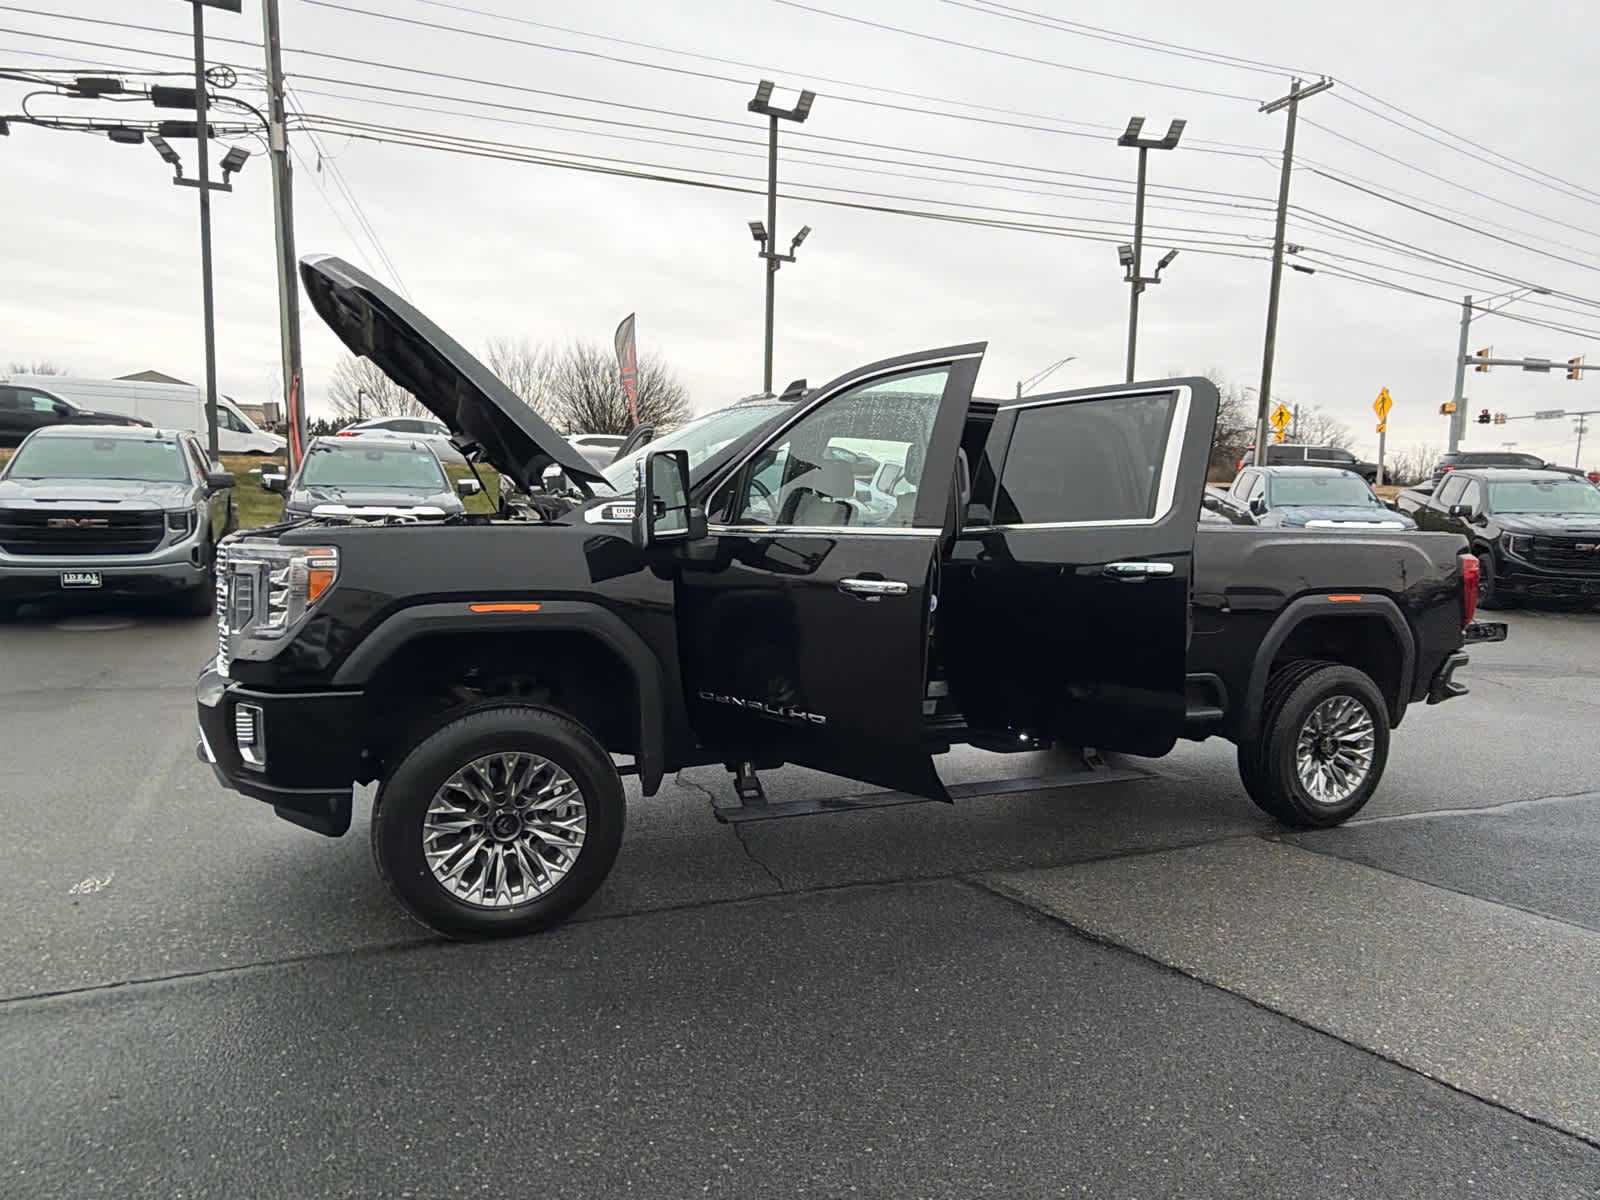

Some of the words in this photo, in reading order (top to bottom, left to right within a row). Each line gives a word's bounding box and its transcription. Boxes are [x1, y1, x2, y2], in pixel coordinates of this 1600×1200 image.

[47, 518, 109, 529] GMC
[63, 573, 99, 581] IDEAL
[699, 691, 784, 716] DENALI
[788, 709, 827, 724] HD
